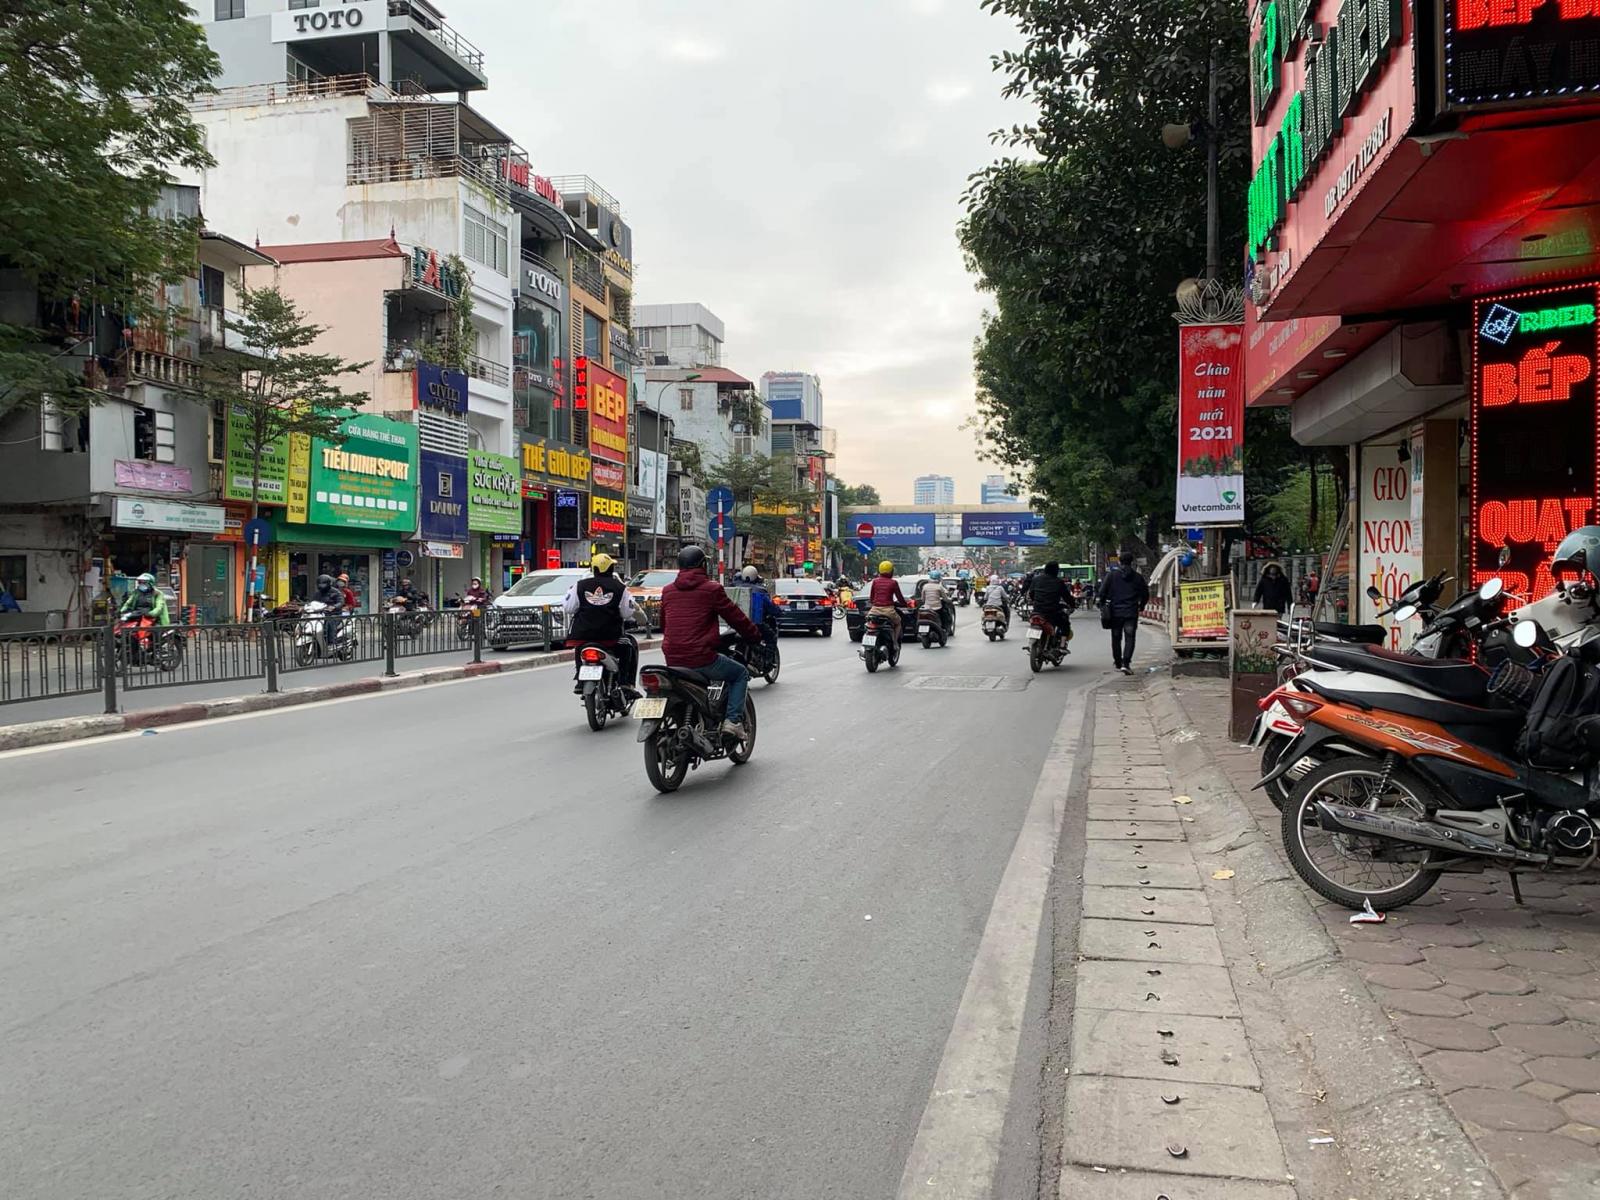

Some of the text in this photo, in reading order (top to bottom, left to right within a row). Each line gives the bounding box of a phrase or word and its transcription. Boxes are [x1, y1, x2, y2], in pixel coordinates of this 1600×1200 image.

[293, 8, 363, 33] TOTO
[527, 269, 562, 299] TOTO
[1194, 362, 1231, 378] Chào
[1483, 340, 1591, 407] BẾP
[594, 378, 625, 423] BẾP
[1197, 386, 1226, 399] năm
[1199, 407, 1224, 421] mới
[362, 427, 378, 440] HÀNG
[391, 435, 406, 446] THAO
[1189, 426, 1233, 441] 2021
[323, 444, 350, 471] TIẾN
[376, 458, 409, 481] SPORT
[522, 439, 546, 473] THẾ
[548, 447, 571, 478] GIỚI
[570, 450, 591, 481] BẾP
[474, 470, 492, 489] SỨC
[681, 488, 691, 499] PHO
[683, 500, 690, 511] TO
[1182, 502, 1242, 512] Vietcombank
[857, 523, 925, 535] nasonic
[1480, 497, 1593, 552] QUẠT
[1364, 520, 1411, 554] NGON
